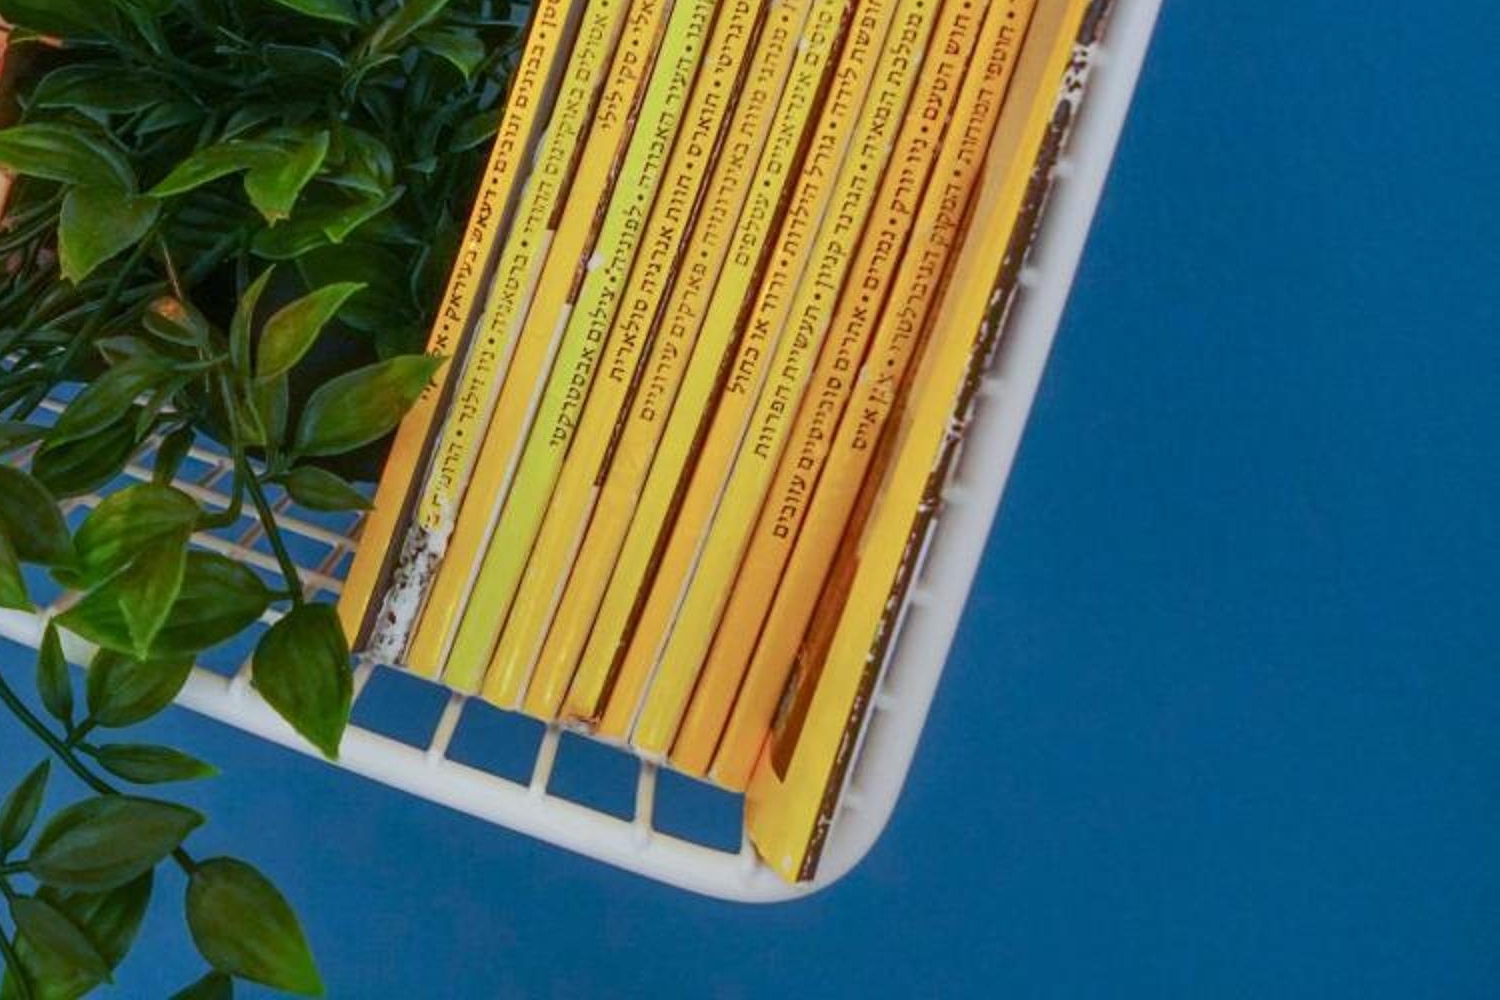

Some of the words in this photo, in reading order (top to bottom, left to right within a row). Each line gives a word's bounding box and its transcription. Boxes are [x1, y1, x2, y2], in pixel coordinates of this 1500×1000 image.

[886, 12, 923, 85] ממלכת
[944, 13, 970, 55] חוש
[615, 50, 638, 84] סקי
[830, 67, 857, 117] לידה
[922, 61, 952, 121] הטעם
[598, 90, 623, 128] לילי
[686, 92, 719, 157] חוארס
[860, 90, 895, 158] המאיה
[804, 134, 836, 177] גורל
[906, 137, 928, 161] ניו
[664, 174, 692, 222] חוות
[782, 182, 818, 256] הילדות
[833, 175, 867, 234] הגרנד
[889, 168, 914, 215] יורק
[640, 225, 674, 294] אנרגיה
[814, 240, 846, 290] קניון
[862, 229, 895, 290] נמרים
[759, 271, 786, 312] ורוד
[609, 298, 648, 382] סולארית
[749, 318, 769, 340] או
[781, 304, 820, 380] תעשיית
[832, 305, 867, 371] אתרים
[727, 346, 759, 394] כחול
[753, 384, 789, 459] הפרוות
[797, 376, 842, 470] סובייטיים
[772, 474, 806, 539] עזובים
